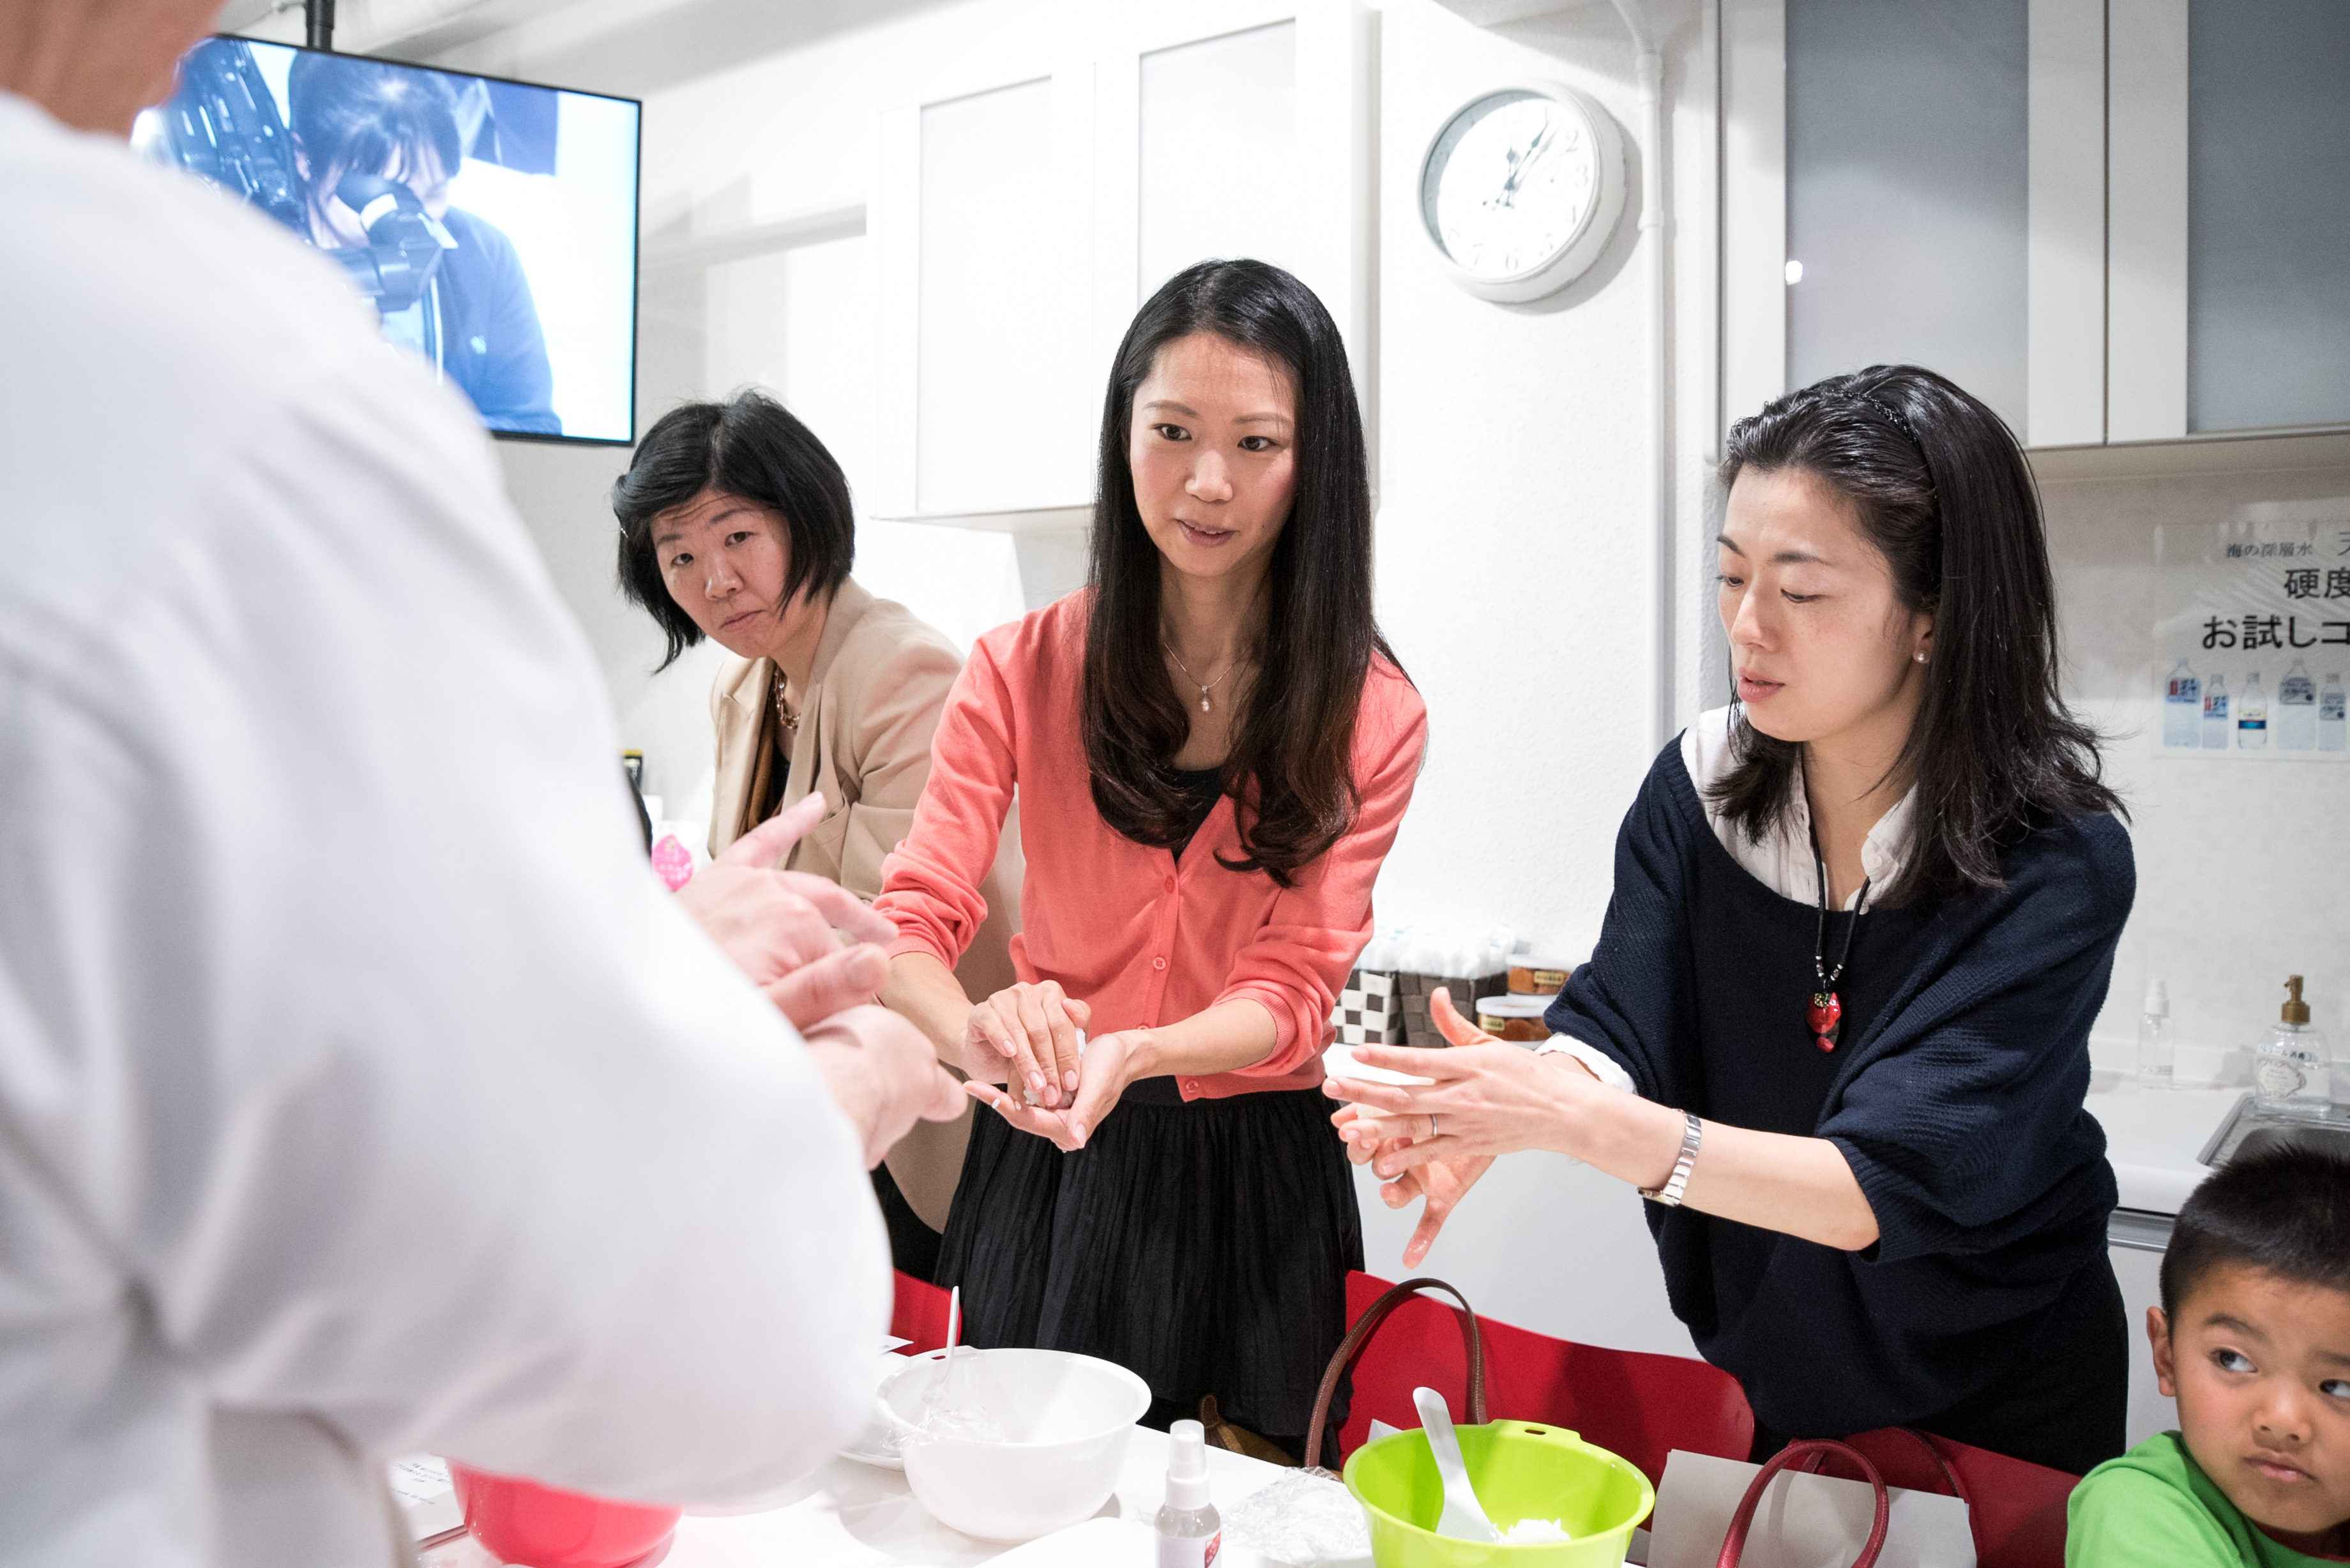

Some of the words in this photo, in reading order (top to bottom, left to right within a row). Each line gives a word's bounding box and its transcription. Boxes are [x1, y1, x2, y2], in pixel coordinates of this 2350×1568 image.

[1565, 127, 1580, 153] 2
[1573, 163, 1589, 189] 3
[1472, 243, 1483, 266] 7
[1539, 233, 1554, 257] 5
[1505, 248, 1519, 273] 6
[2226, 542, 2313, 559] 海の深層水
[2284, 567, 2350, 599] 硬度
[2202, 614, 2350, 650] お試しコ
